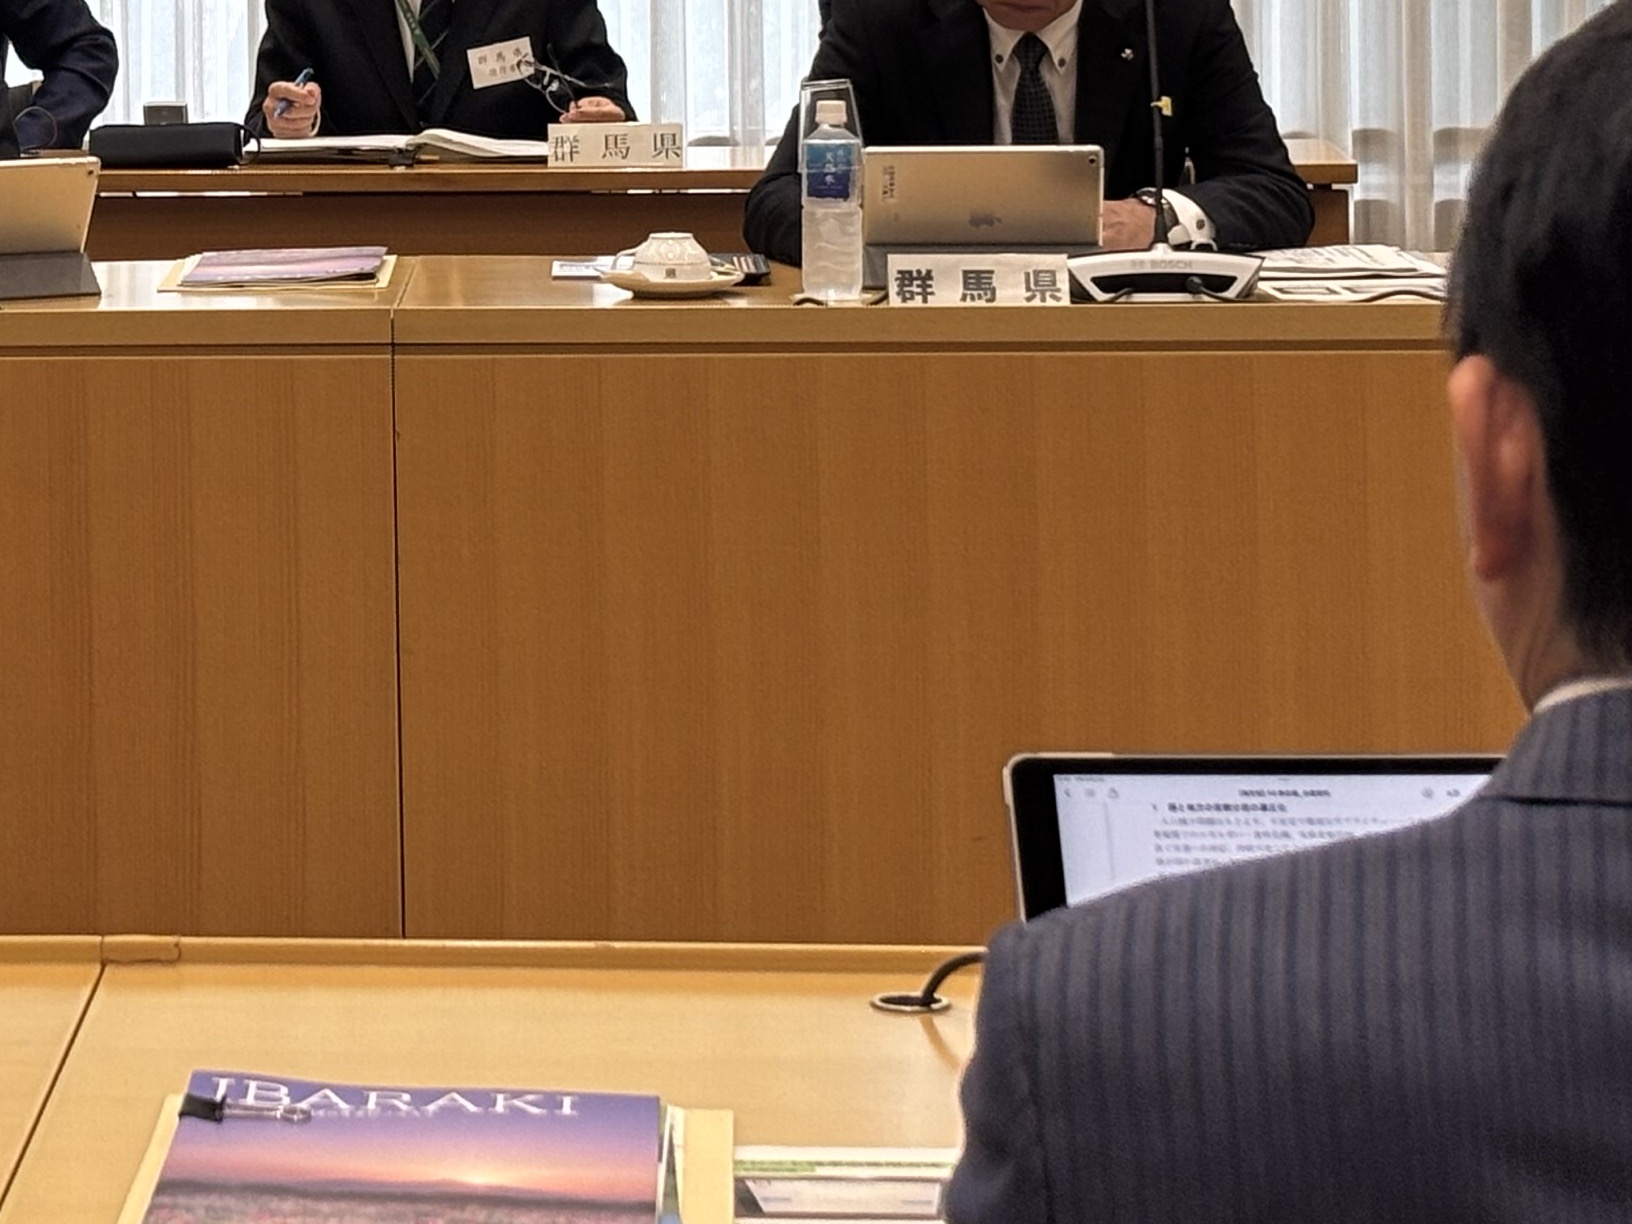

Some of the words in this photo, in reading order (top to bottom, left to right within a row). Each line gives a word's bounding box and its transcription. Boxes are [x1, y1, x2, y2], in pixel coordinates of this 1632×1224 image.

[551, 132, 682, 163] 群馬県
[894, 268, 1064, 305] 群馬県
[210, 1075, 580, 1117] IBARAKI
